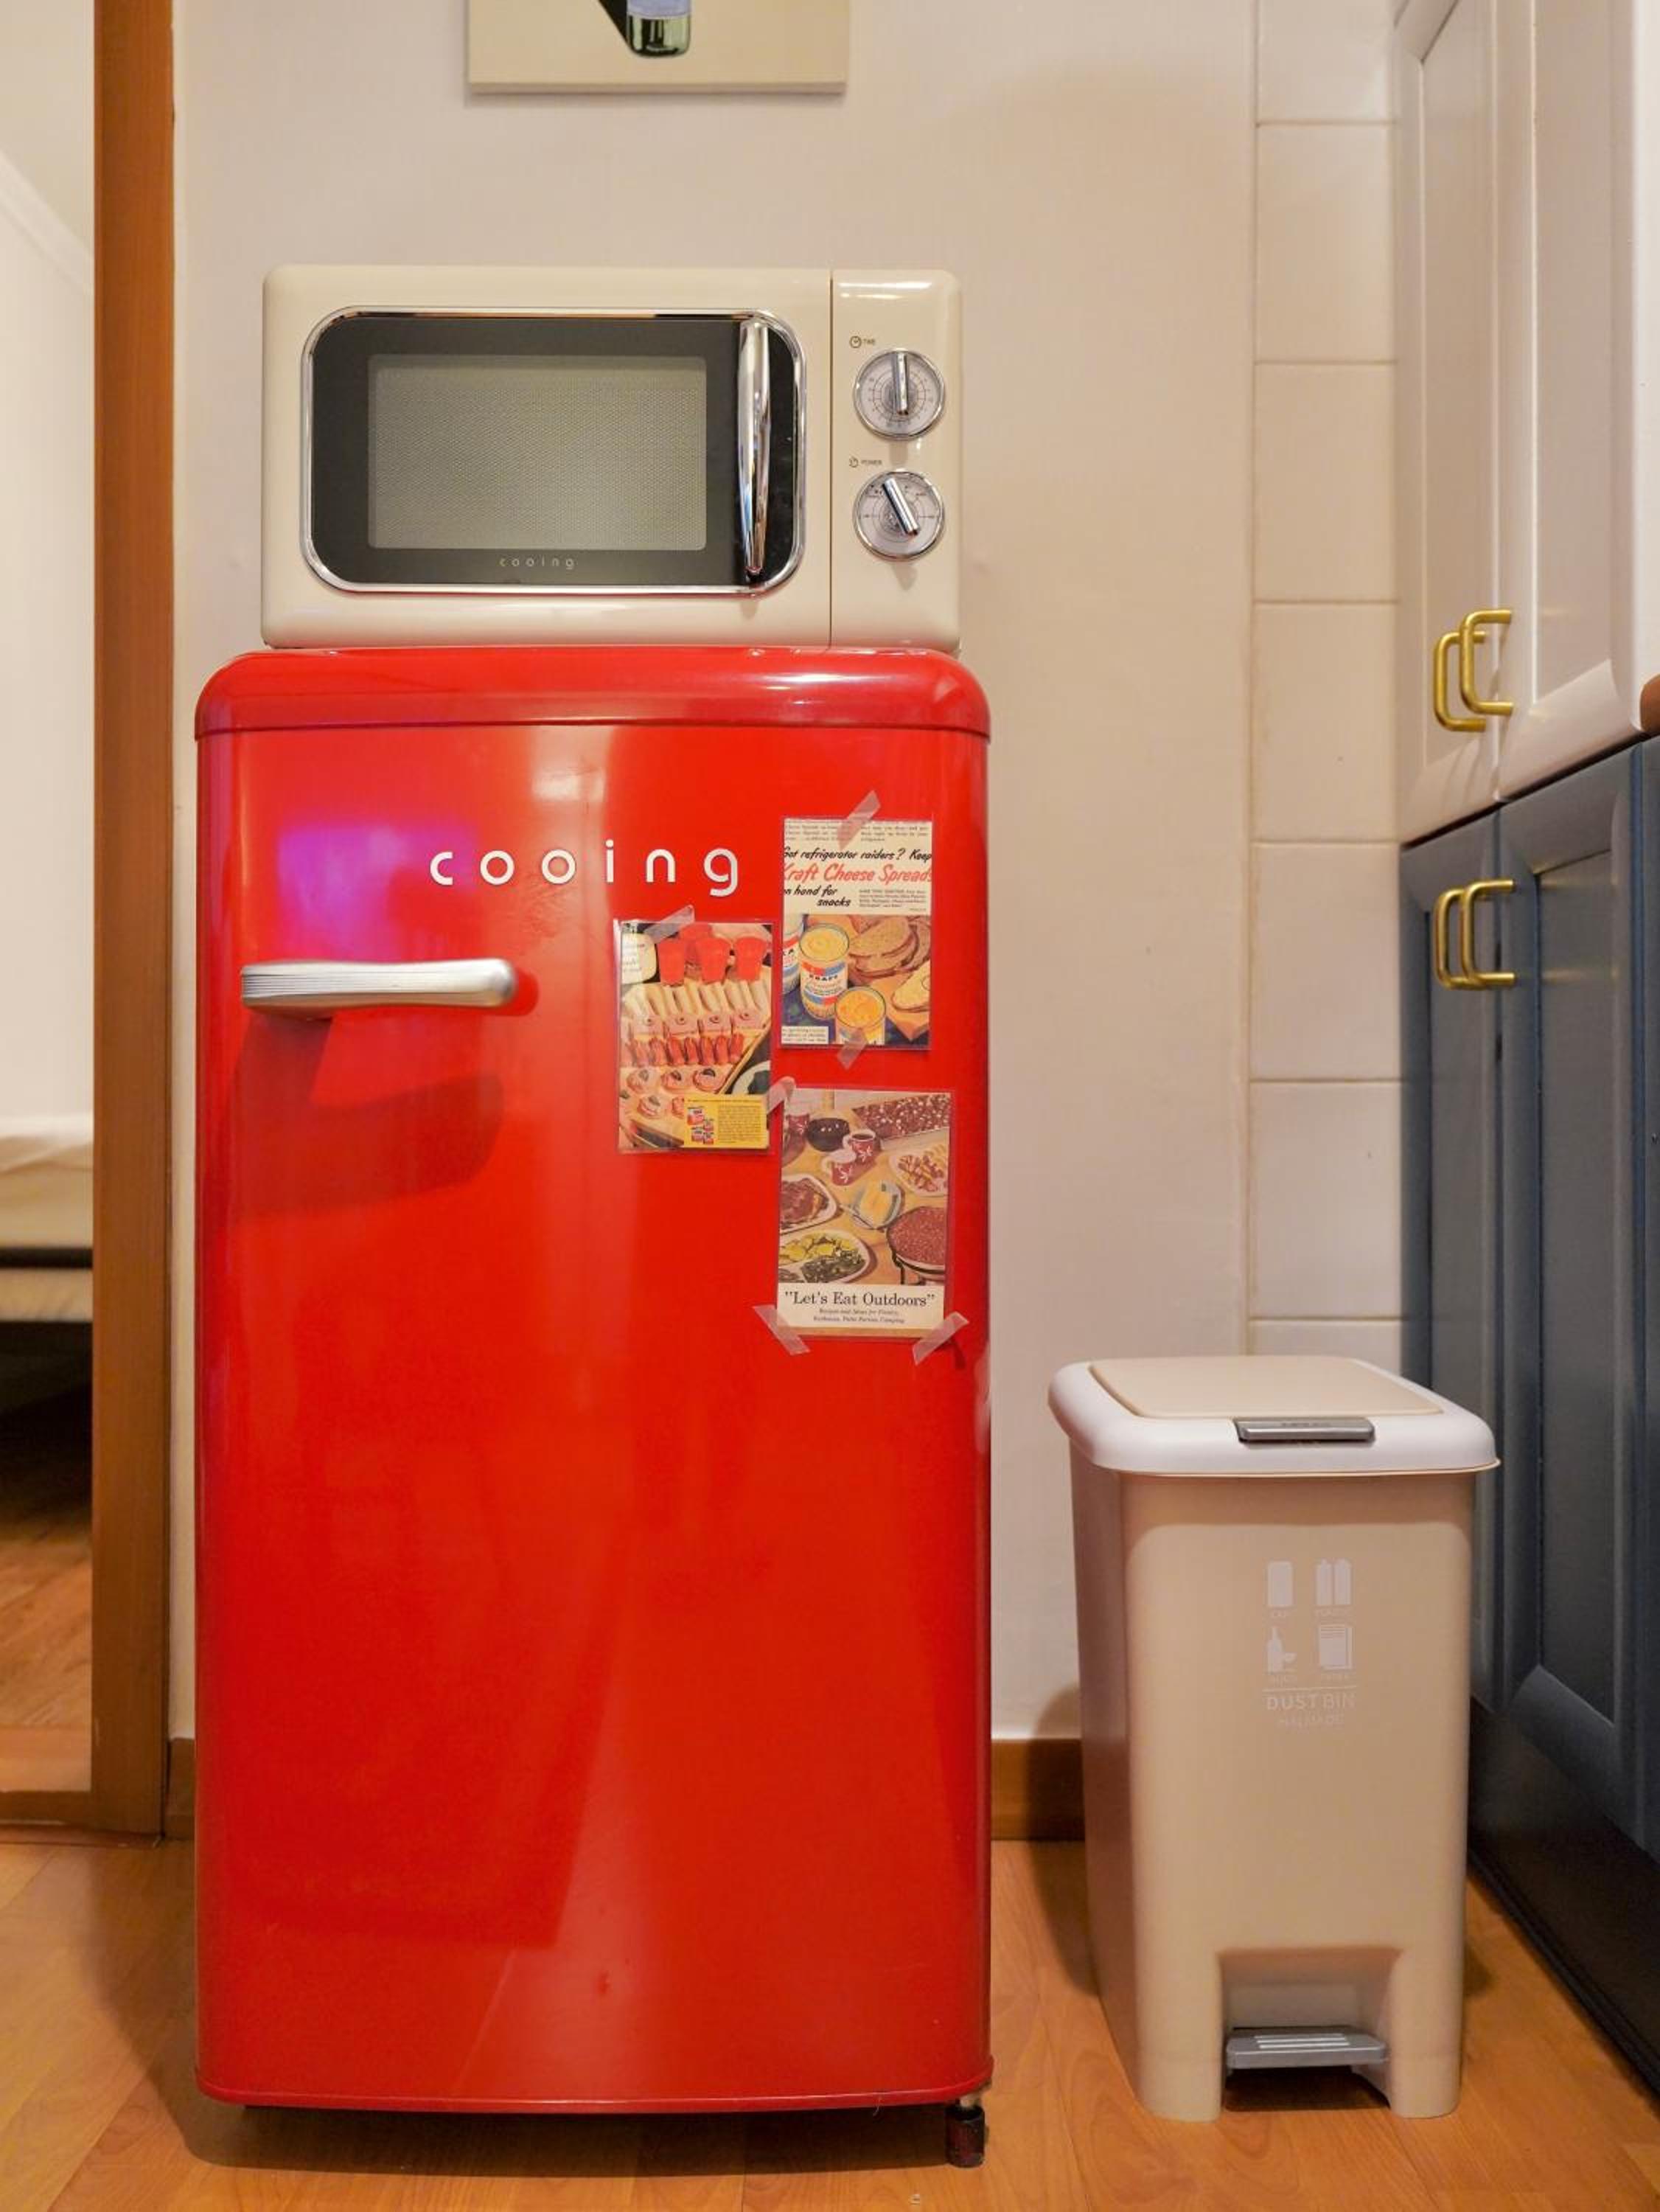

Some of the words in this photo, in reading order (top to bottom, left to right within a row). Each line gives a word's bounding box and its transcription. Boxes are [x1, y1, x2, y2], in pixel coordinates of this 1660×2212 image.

[499, 556, 574, 569] cooing
[800, 847, 859, 861] refrigerator
[909, 849, 932, 863] Keep
[430, 838, 739, 897] cooing
[823, 862, 875, 883] Cheese
[793, 884, 822, 895] hand
[820, 884, 838, 897] for
[816, 897, 851, 907] snacks
[785, 1291, 828, 1304] "Let's
[833, 1291, 857, 1304] Eat
[863, 1291, 935, 1307] Outdoors"
[1266, 1694, 1317, 1711] DUST
[1322, 1692, 1356, 1710] BIN
